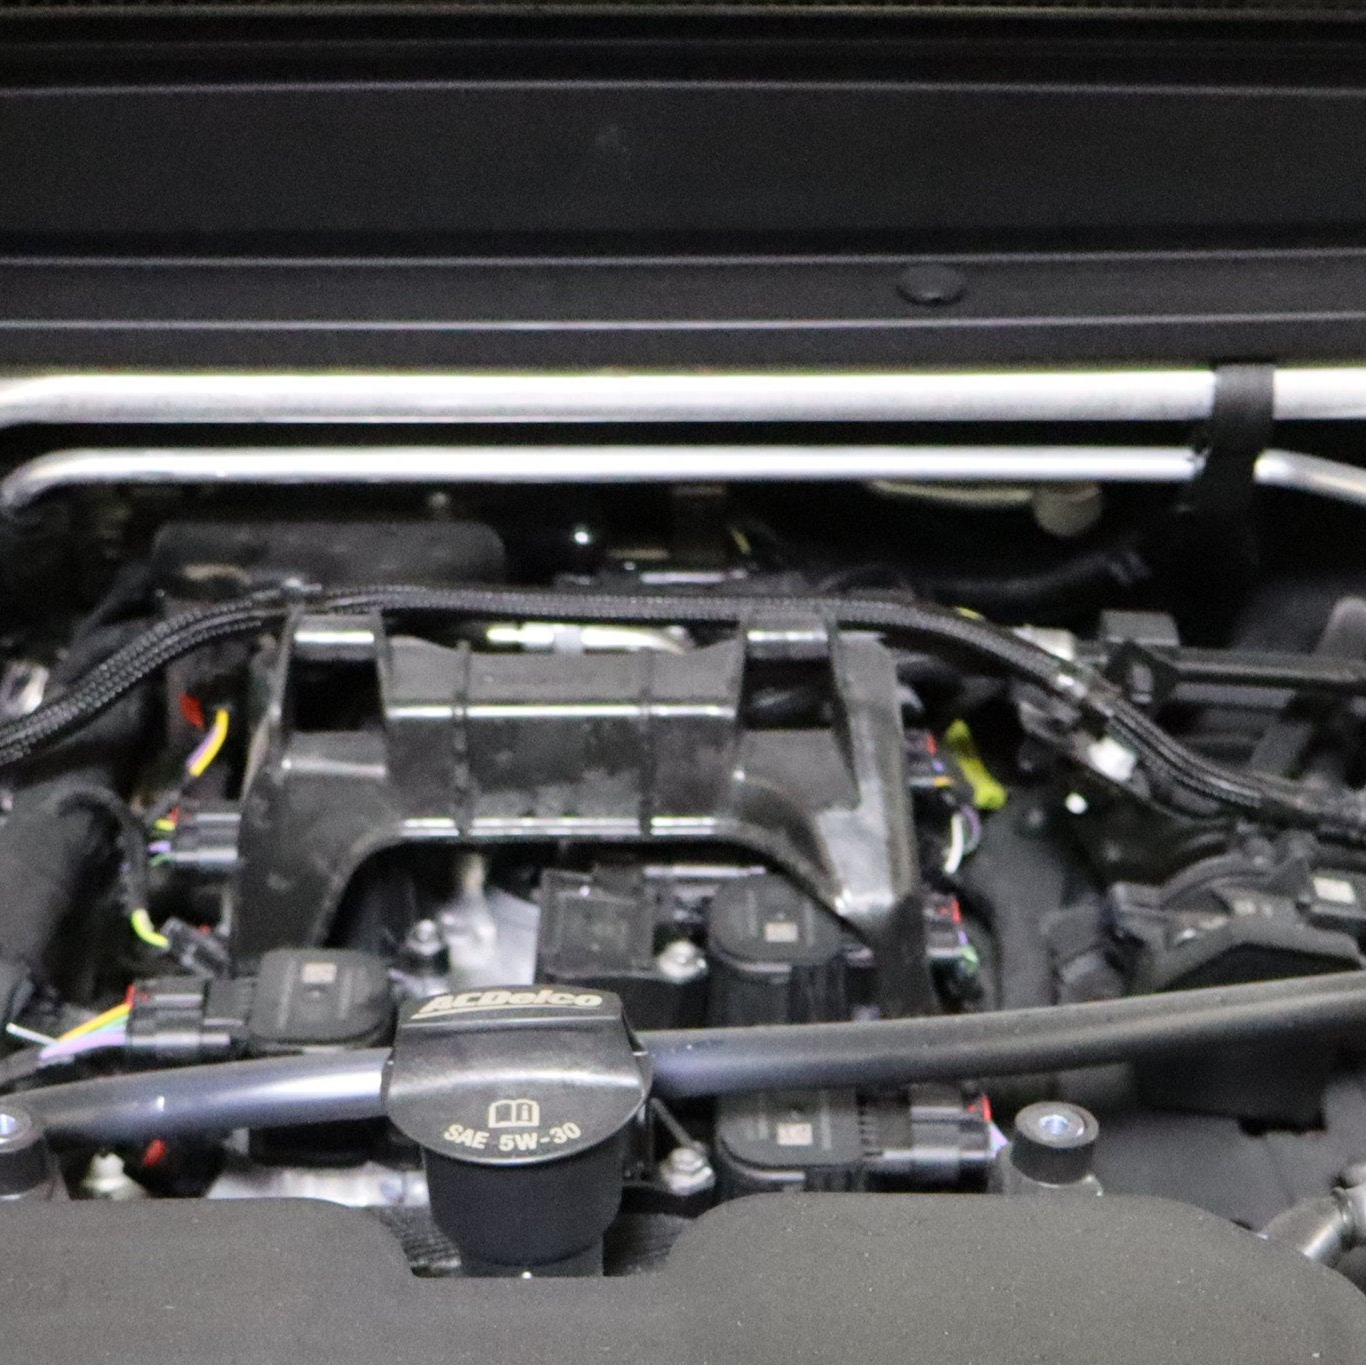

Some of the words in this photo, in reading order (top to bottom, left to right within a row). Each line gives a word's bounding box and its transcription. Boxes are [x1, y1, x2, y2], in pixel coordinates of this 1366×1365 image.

[413, 989, 603, 1017] ACDelco
[443, 1123, 490, 1150] SAE
[498, 1121, 582, 1152] 5W-30
